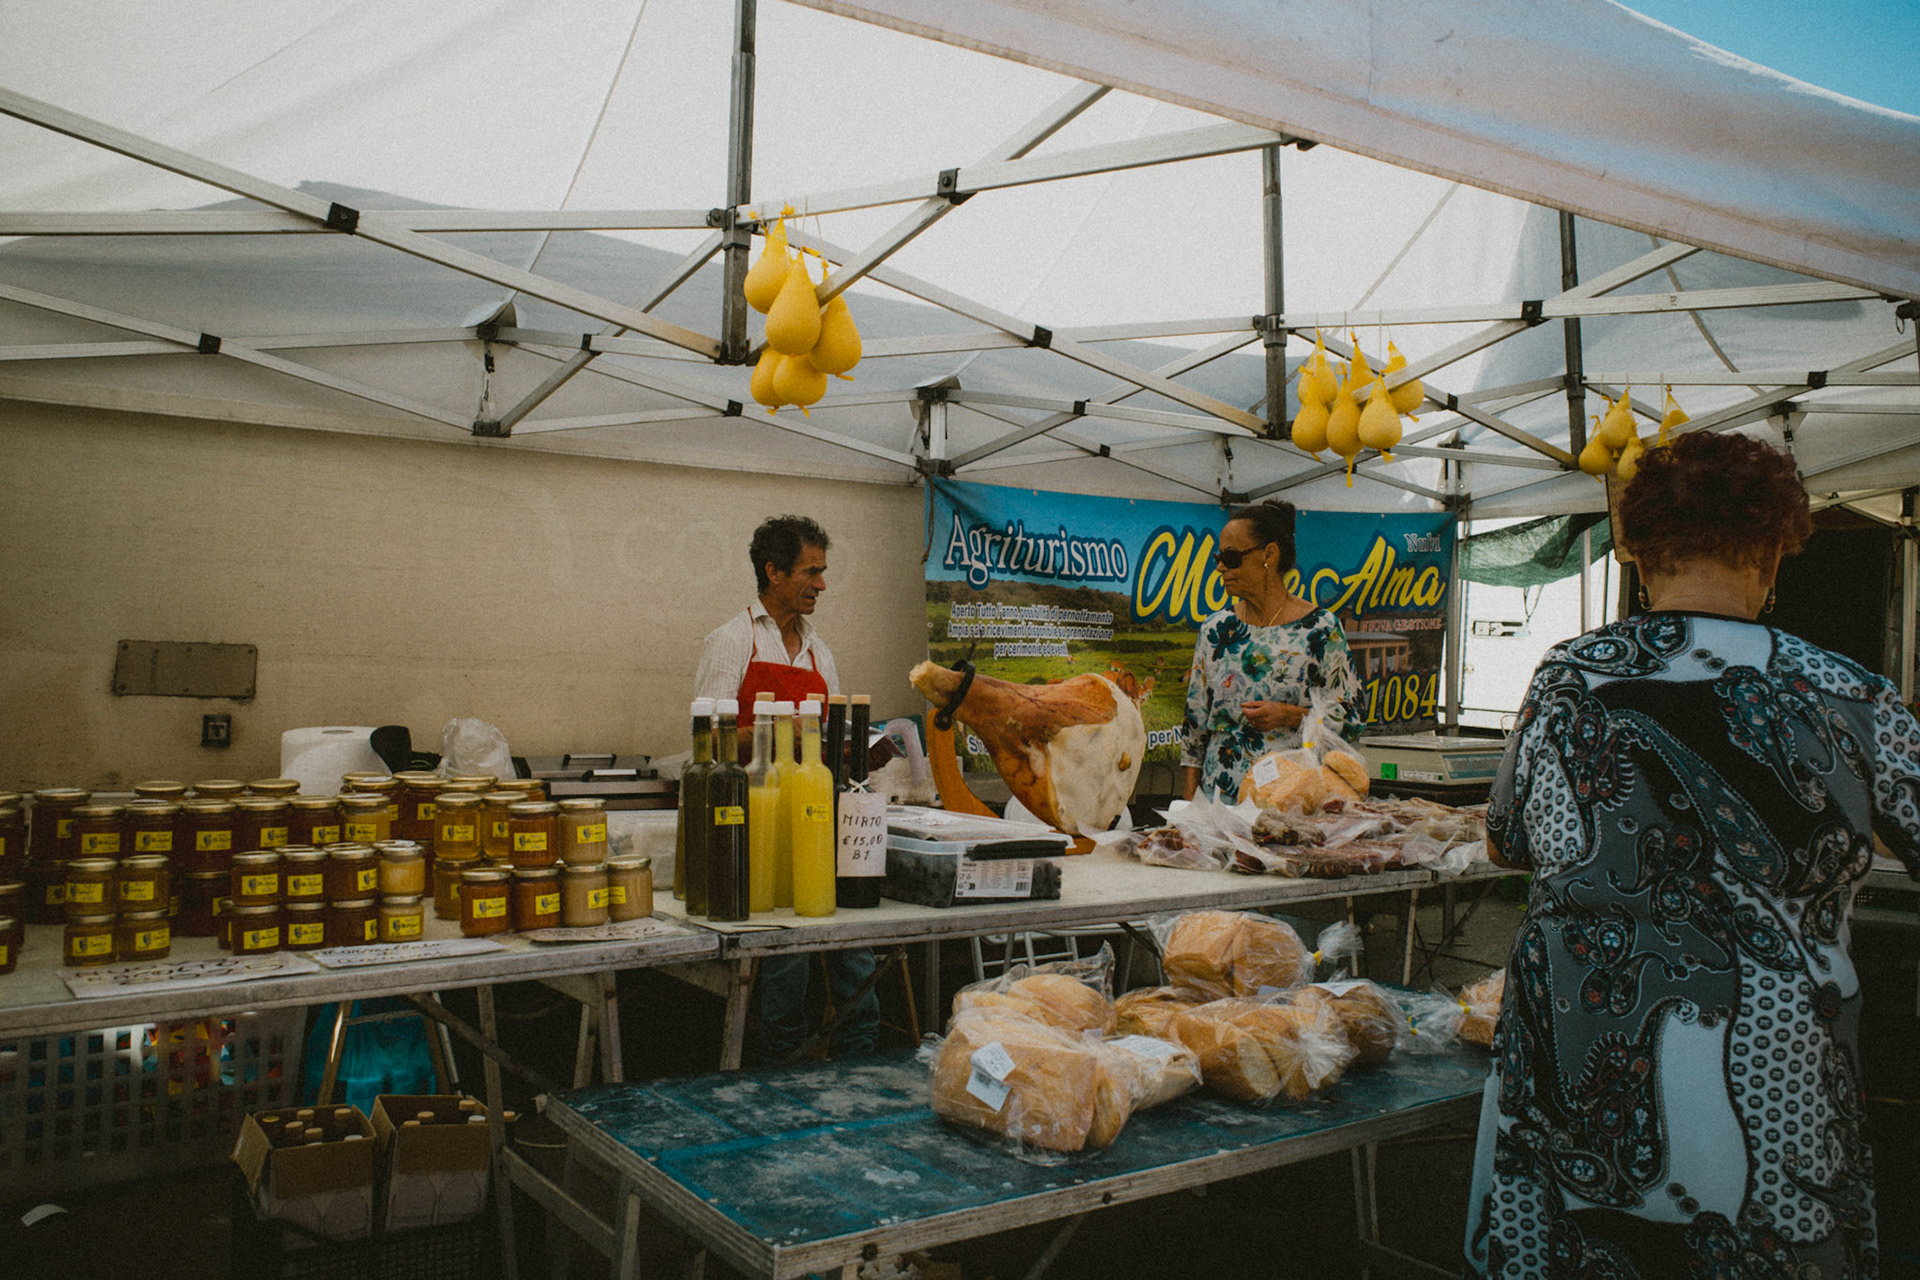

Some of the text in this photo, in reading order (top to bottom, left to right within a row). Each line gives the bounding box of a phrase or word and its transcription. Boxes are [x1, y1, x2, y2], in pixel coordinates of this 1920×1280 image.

[945, 513, 1128, 586] Agriturismo
[1136, 532, 1446, 622] Moe Alma
[951, 602, 976, 621] Aperto
[976, 602, 997, 619] Tutto
[1050, 605, 1060, 620] di
[1058, 608, 1114, 625] pernottamento
[948, 620, 969, 641] Ampia
[986, 621, 1026, 638] ricevimenti
[1066, 625, 1114, 643] prenotazione
[1362, 617, 1442, 633] NUOVA GESTIONE
[994, 643, 1008, 660] per
[1008, 640, 1042, 657] cerimonie
[1042, 641, 1051, 656] ed
[1149, 731, 1172, 749] per
[843, 814, 882, 828] MIRTO
